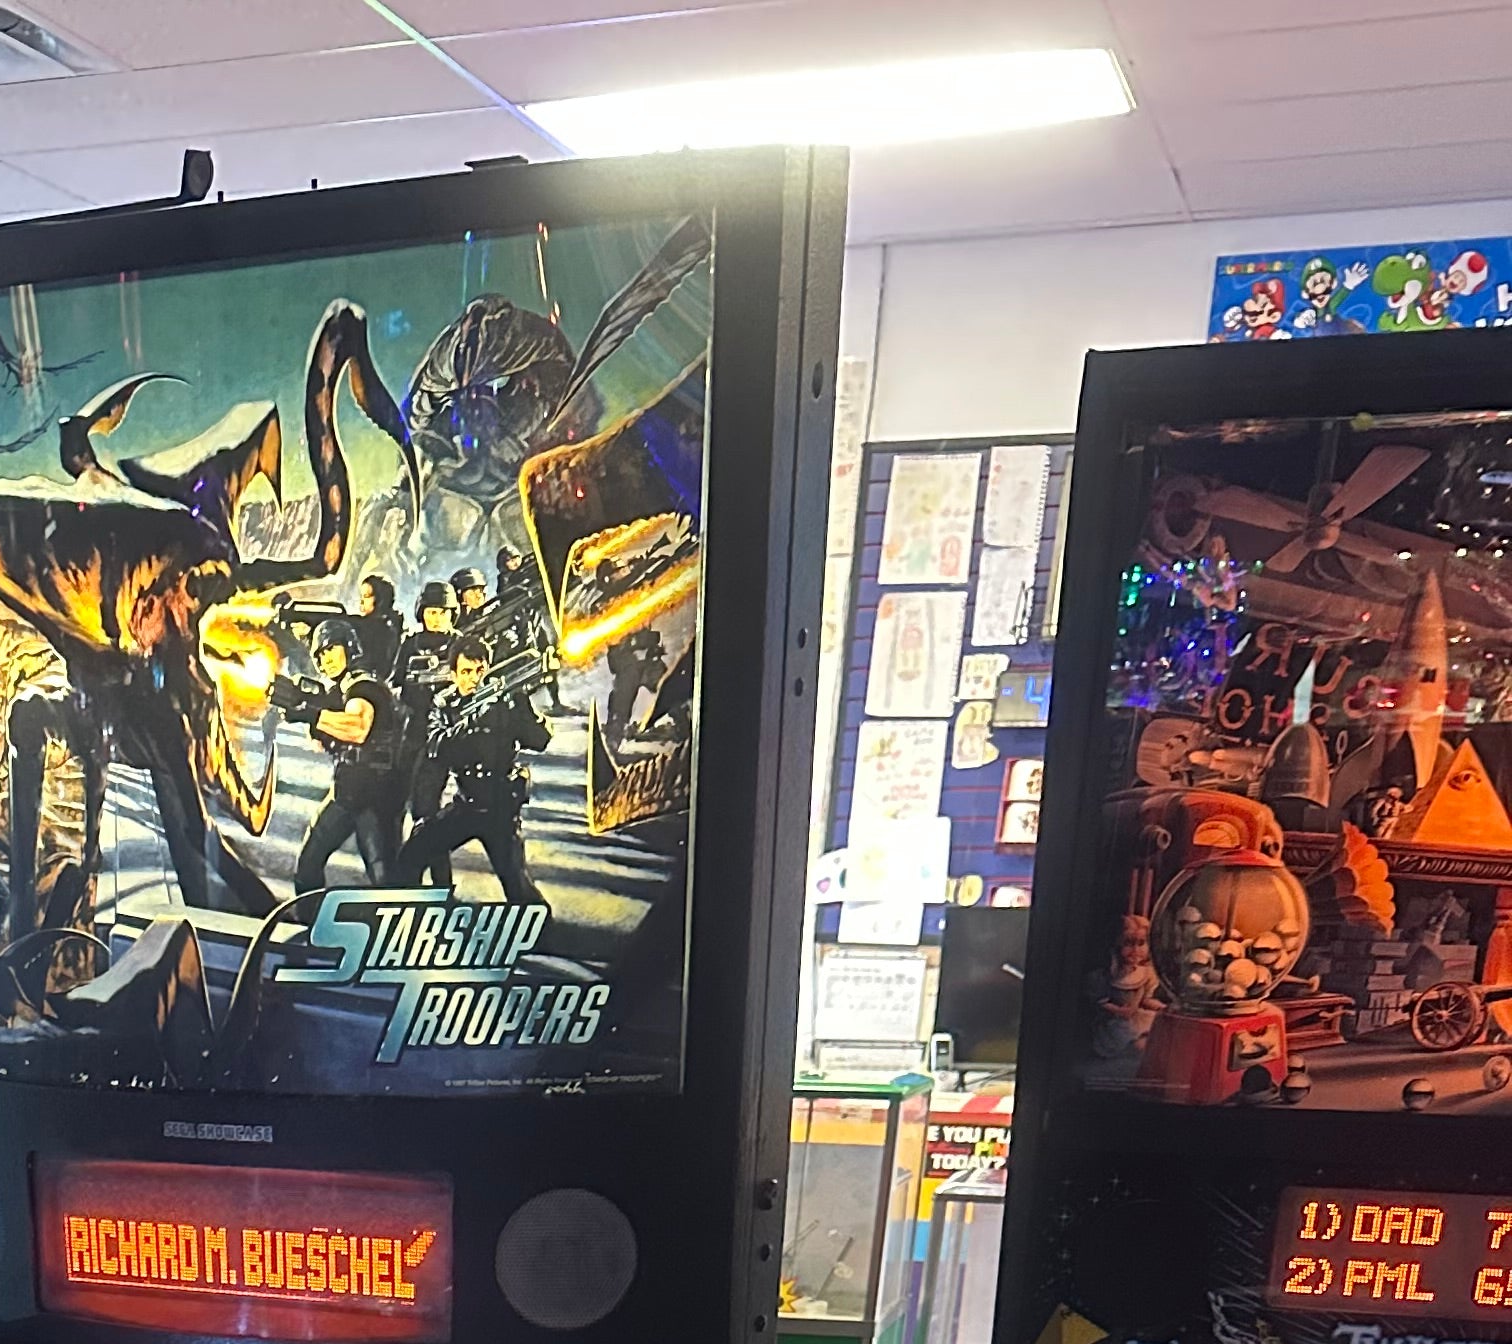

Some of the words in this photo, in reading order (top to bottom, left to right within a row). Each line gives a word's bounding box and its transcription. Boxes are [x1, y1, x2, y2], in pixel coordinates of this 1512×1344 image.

[275, 887, 554, 983] STARSHIP
[360, 967, 612, 1065] TROOPERS
[163, 1120, 197, 1139] SEGA
[197, 1122, 273, 1143] SHOWCASE
[942, 1127, 981, 1143] YOU
[930, 1153, 1006, 1171] TODAY?
[1300, 1202, 1342, 1240] 1)
[1351, 1205, 1445, 1246] DAD
[68, 1217, 199, 1281] RICHARD
[202, 1224, 238, 1287] M.
[242, 1228, 416, 1300] BUESCHEL
[1284, 1256, 1333, 1295] 2)
[1343, 1260, 1435, 1301] PML
